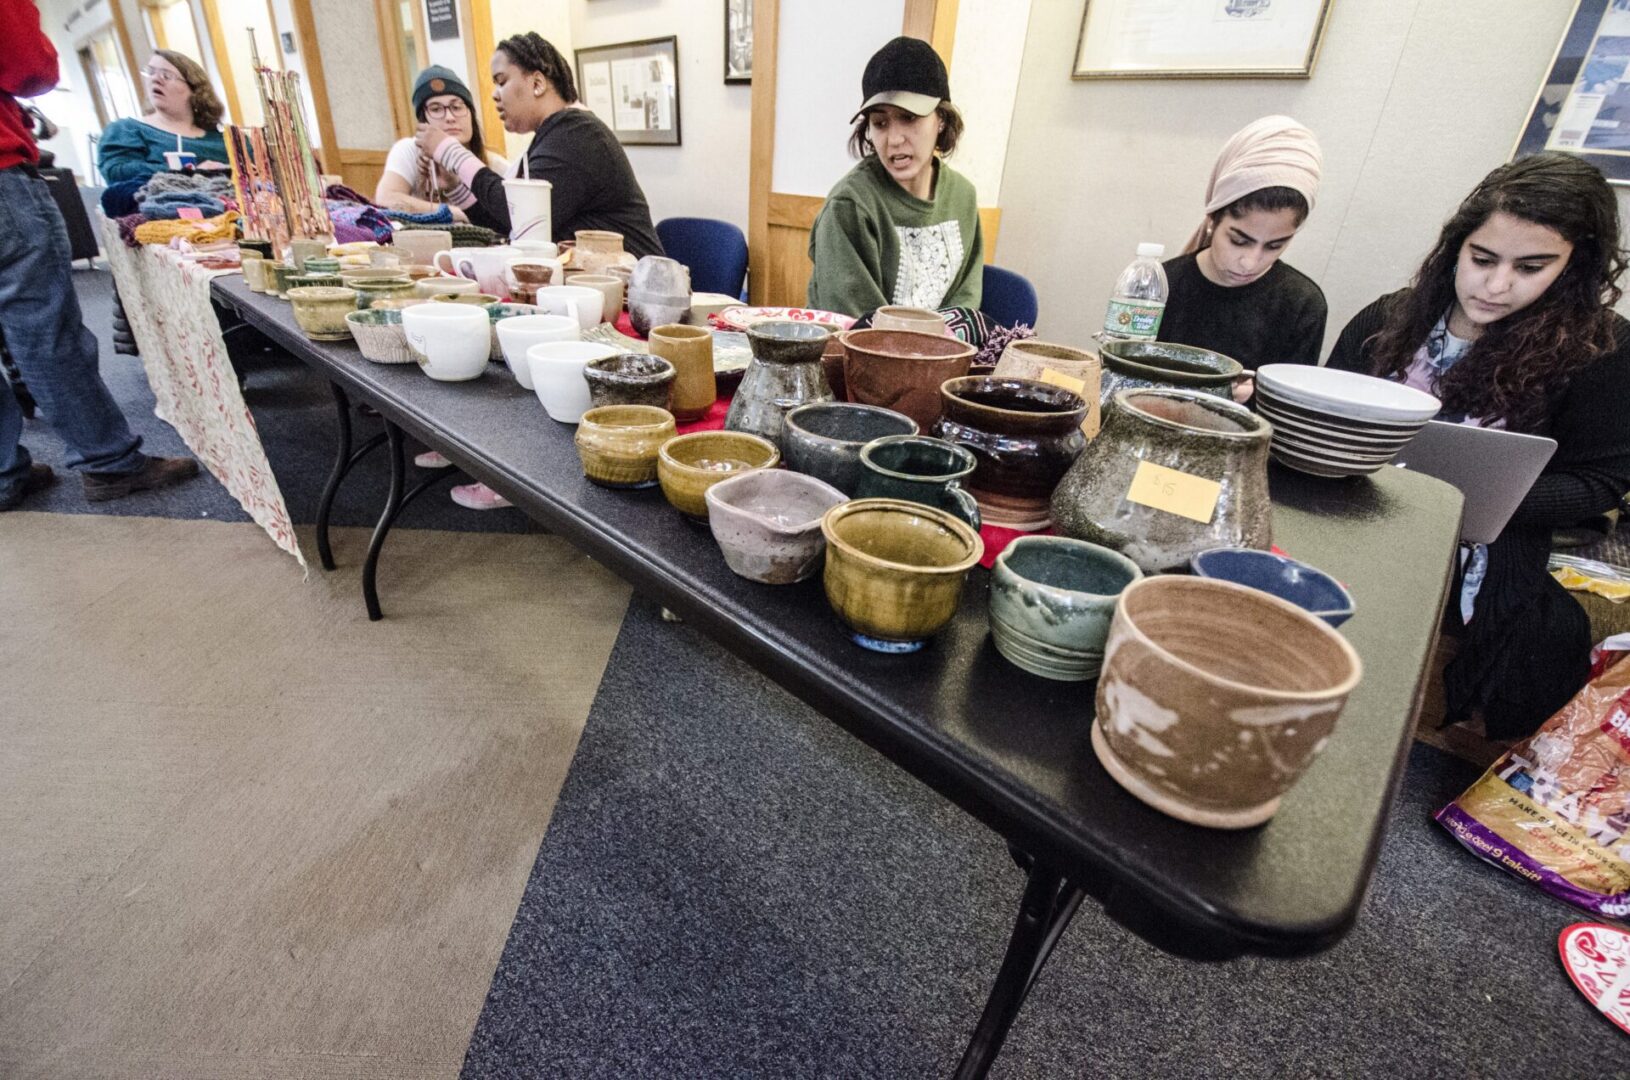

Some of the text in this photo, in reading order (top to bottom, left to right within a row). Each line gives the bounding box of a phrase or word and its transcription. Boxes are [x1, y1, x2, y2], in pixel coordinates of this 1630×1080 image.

[1508, 797, 1539, 817] MAKE
[1582, 844, 1608, 864] YOUR
[1491, 847, 1503, 858] 9
